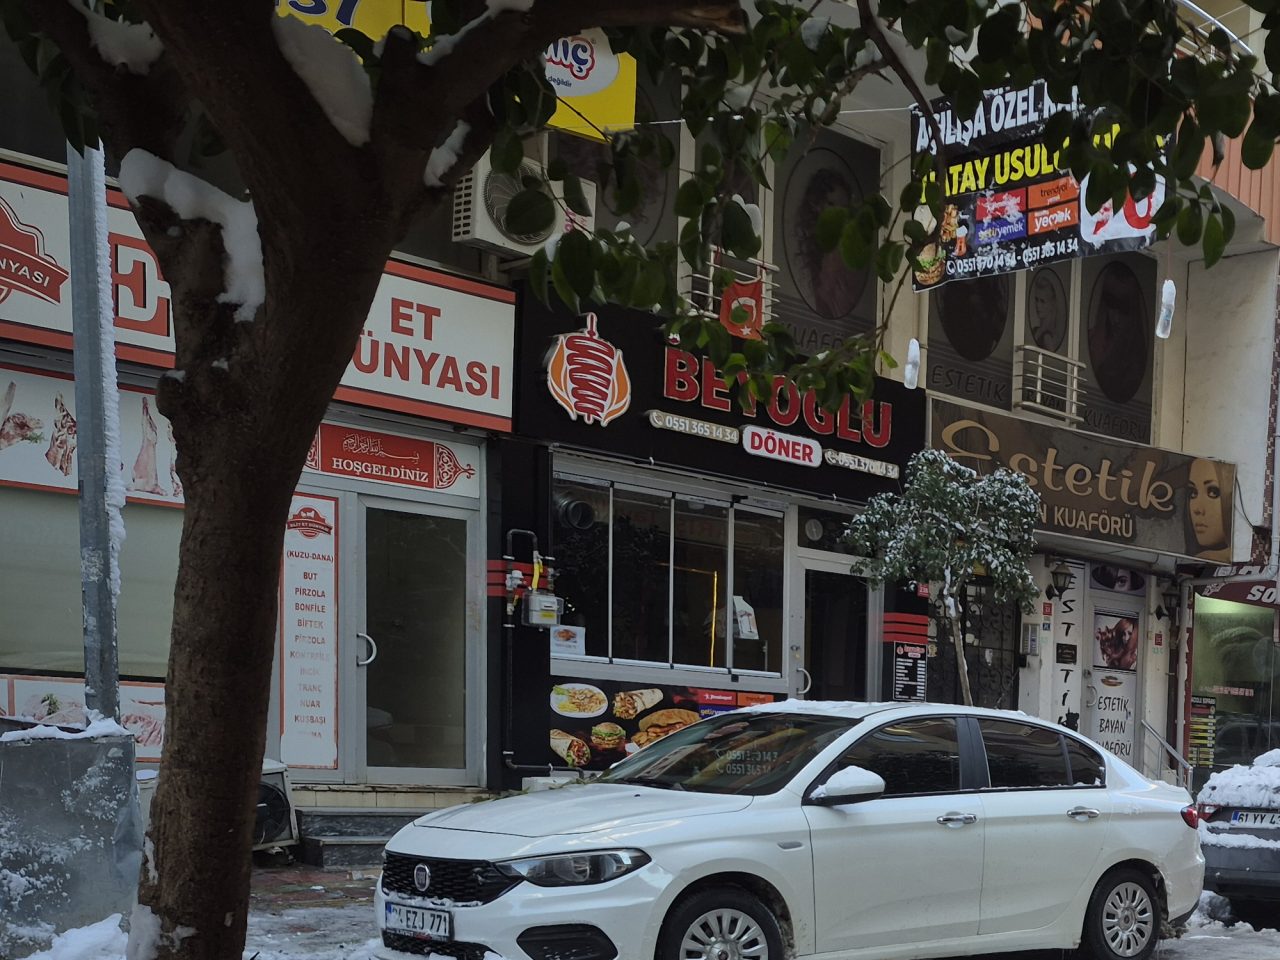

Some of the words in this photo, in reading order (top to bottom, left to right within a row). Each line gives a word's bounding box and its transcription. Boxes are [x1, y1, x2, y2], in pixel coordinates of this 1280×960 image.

[990, 85, 1039, 132] ÖZEL
[994, 142, 1060, 185] USUL
[1034, 207, 1072, 233] yemek
[1067, 237, 1079, 253] 34
[390, 297, 441, 341] ET
[352, 330, 500, 400] ÜNYASI
[932, 365, 1009, 401] ESTETİK
[665, 415, 690, 432] 0551
[691, 419, 711, 437] 365
[711, 425, 724, 439] 14
[724, 428, 738, 443] 34
[750, 431, 814, 463] DÖNER
[331, 457, 429, 484] HOŞGELDİNİZ
[1053, 505, 1133, 538] KUAFÖRÜ
[303, 572, 318, 581] BUT
[295, 586, 326, 598] PİRZOLA
[295, 602, 326, 613] BONFİLE
[297, 618, 324, 629] BİFTEK
[1098, 695, 1129, 713] ESTETİK
[1099, 718, 1127, 734] BAYAN
[1253, 813, 1267, 825] YY
[405, 909, 425, 931] EZJ
[430, 913, 447, 935] 771
